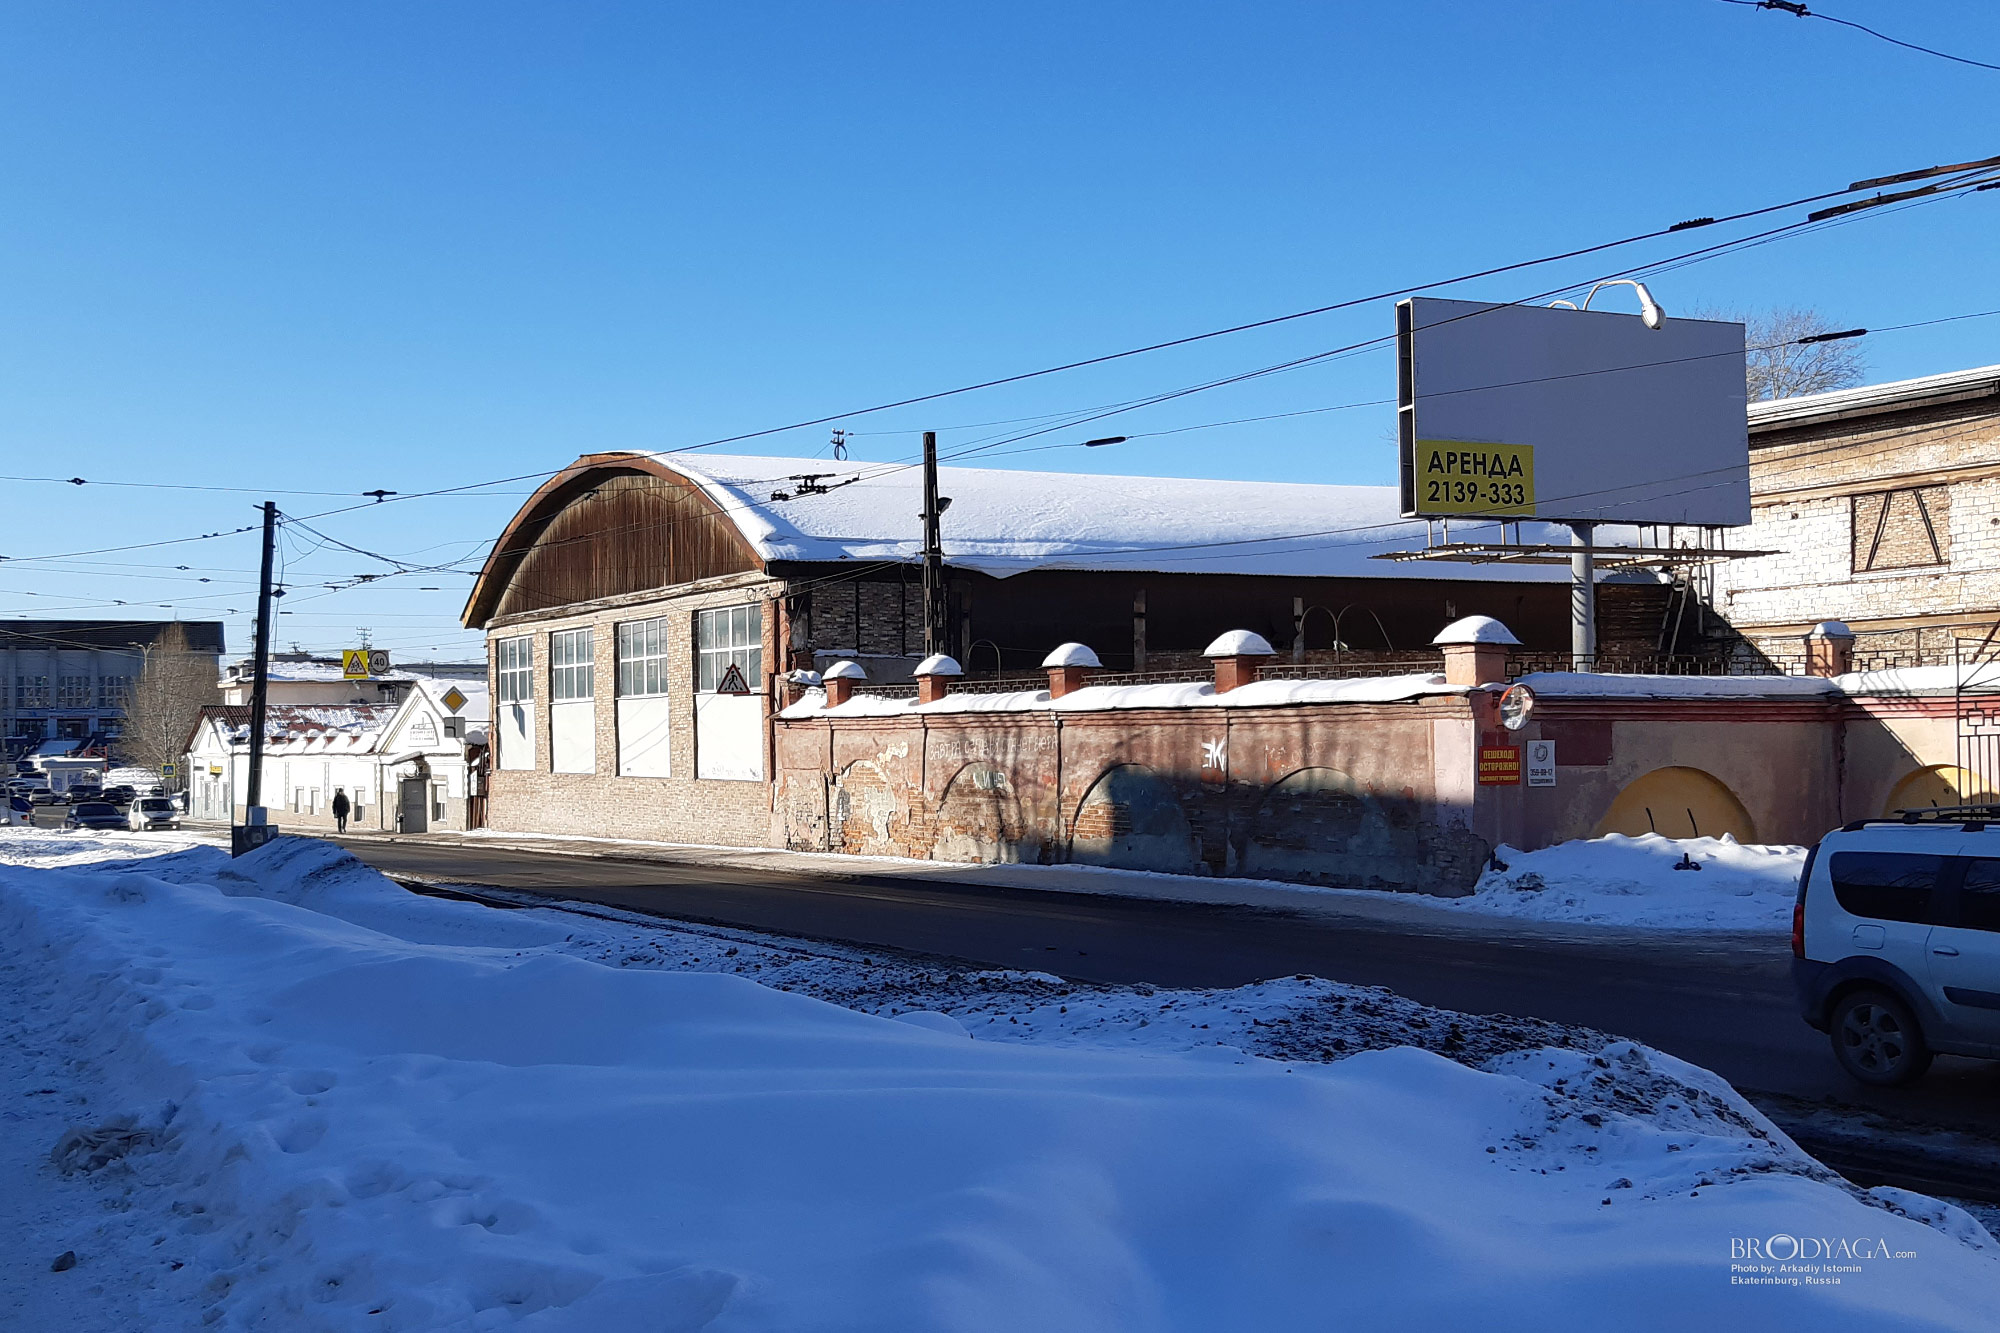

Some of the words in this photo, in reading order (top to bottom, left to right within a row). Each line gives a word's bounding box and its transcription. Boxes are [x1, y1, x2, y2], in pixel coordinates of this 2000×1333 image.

[1427, 451, 1523, 479] АРЕНДА
[1427, 481, 1525, 504] 2139-333
[374, 658, 384, 666] 40
[929, 740, 961, 760] ЗАВТРА
[1483, 749, 1515, 760] ПЕШЕХОД!
[1479, 762, 1520, 772] ОСТОРОЖНО!
